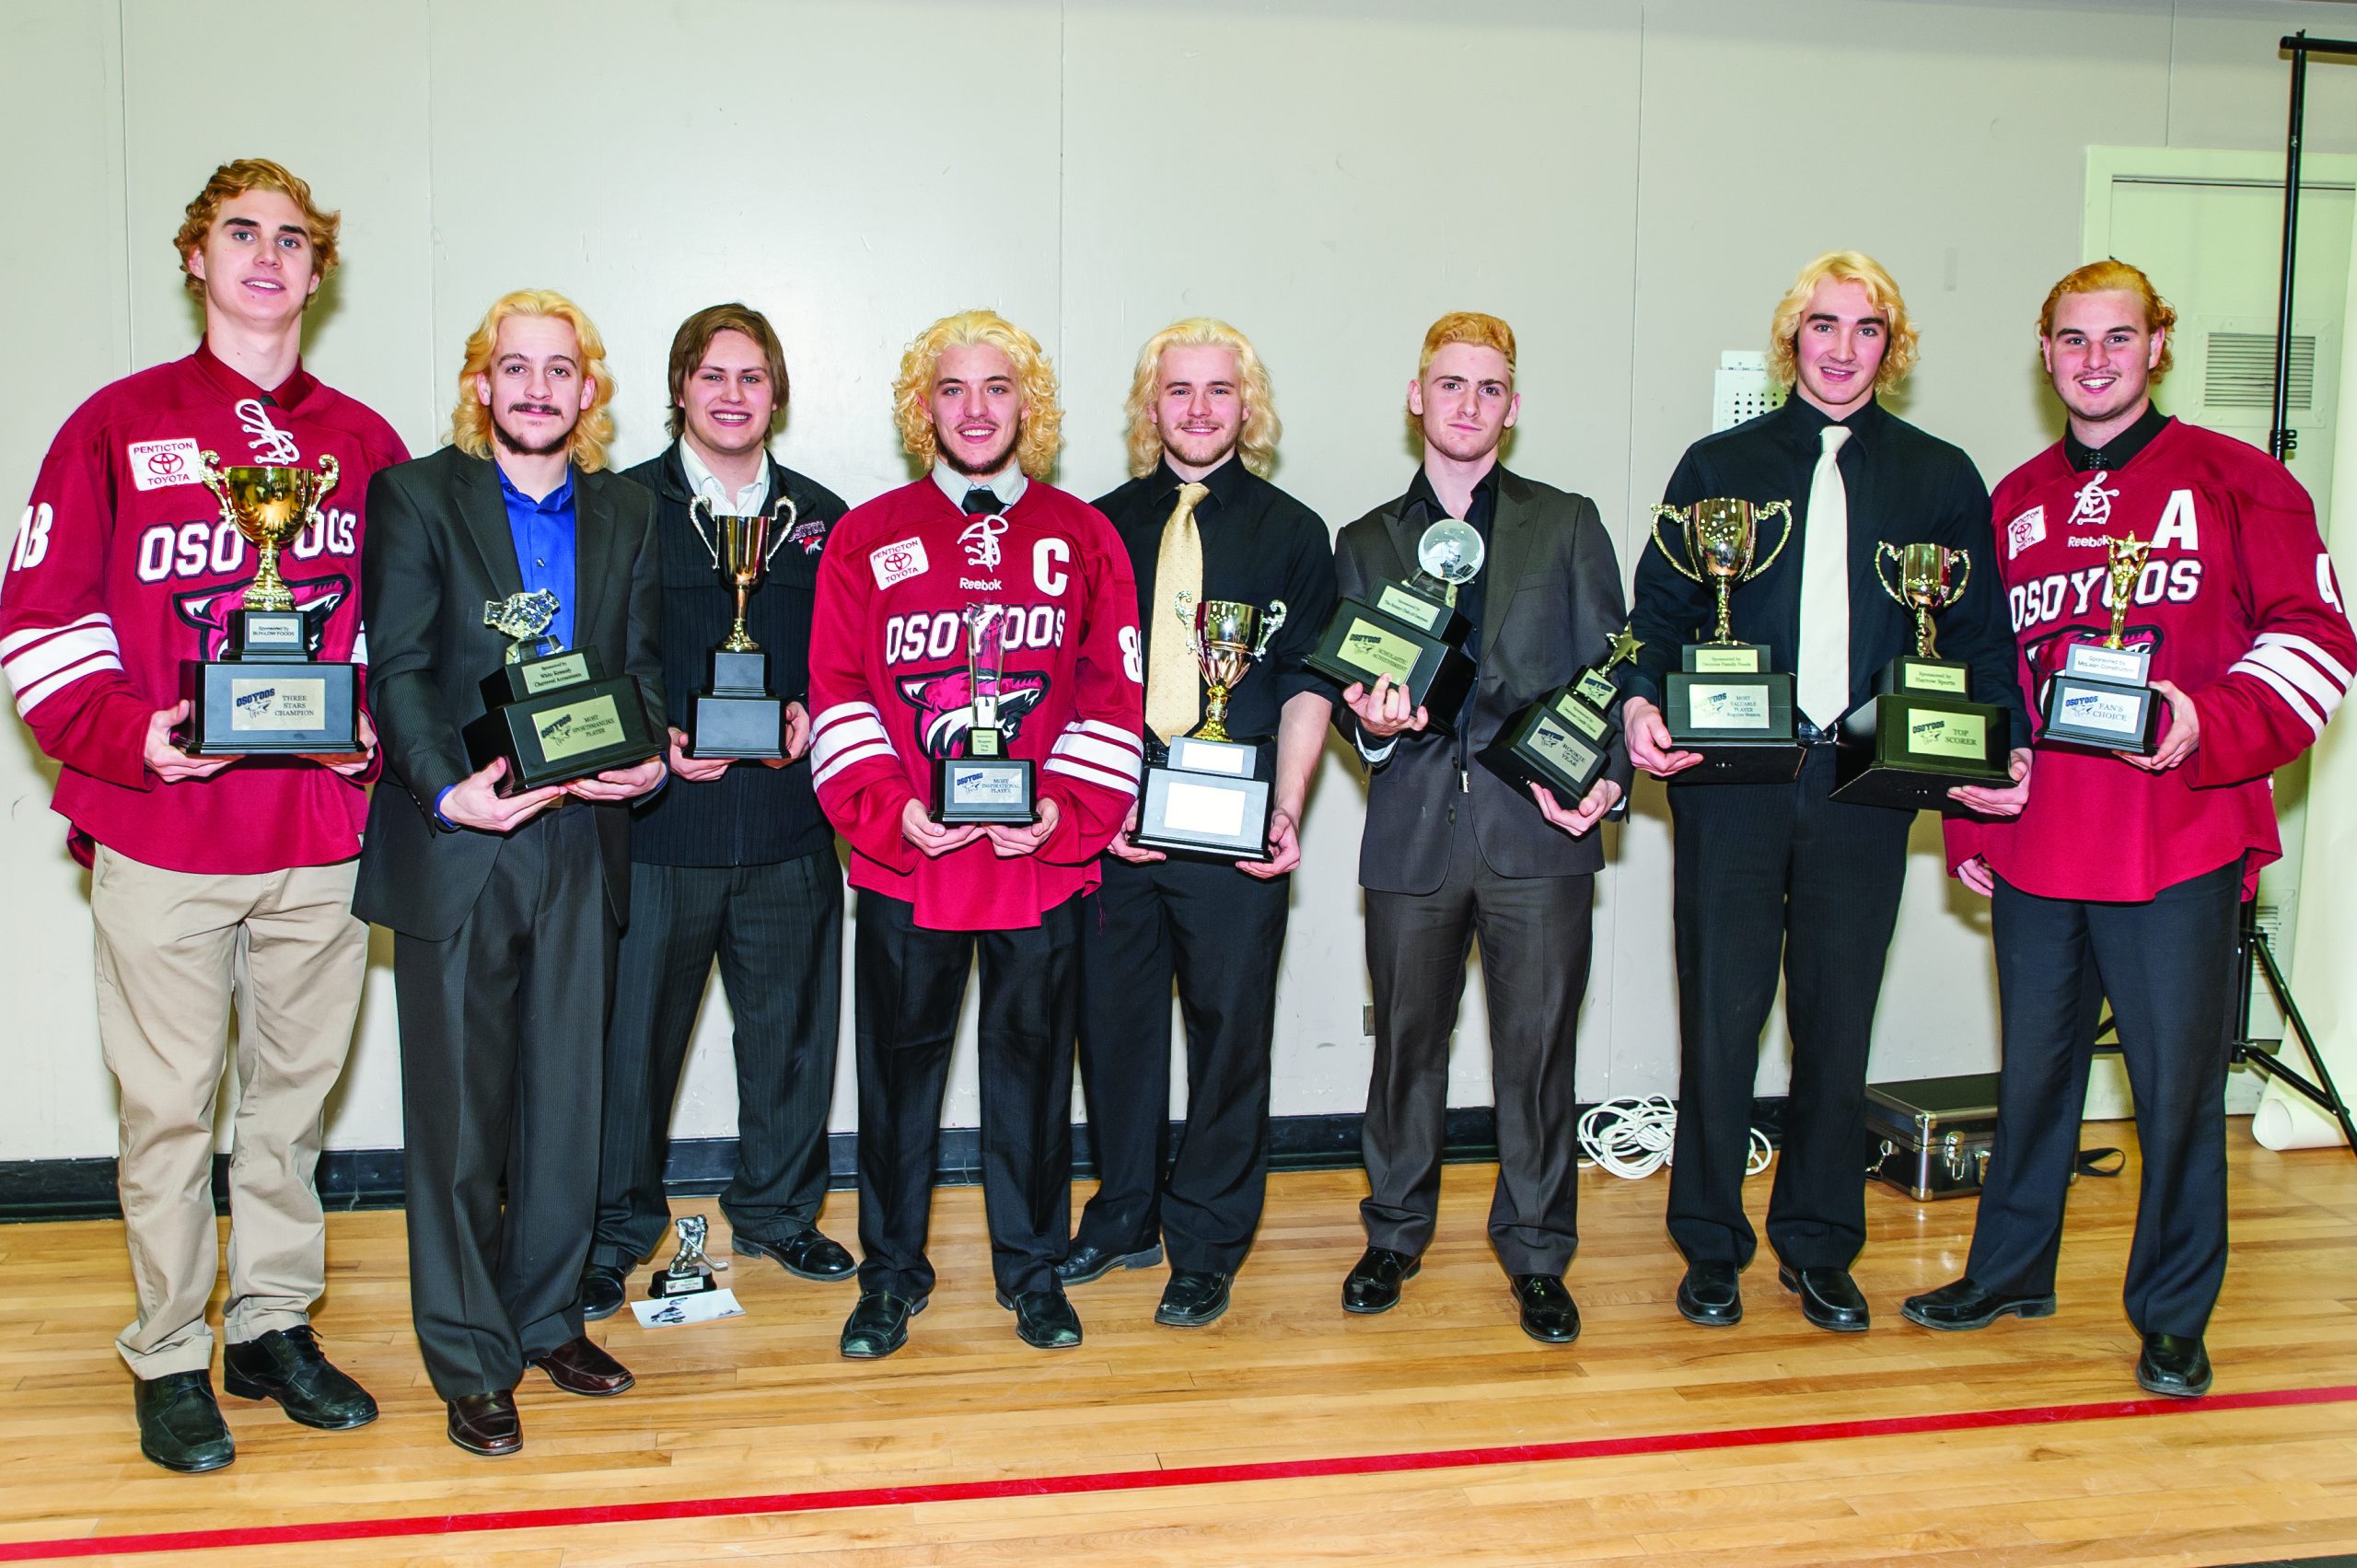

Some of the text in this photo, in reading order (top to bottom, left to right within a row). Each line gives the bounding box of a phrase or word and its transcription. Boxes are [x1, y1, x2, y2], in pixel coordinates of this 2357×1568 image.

[134, 442, 193, 455] PENTICTON
[147, 473, 191, 485] TOYOTA
[2151, 489, 2199, 551] A
[136, 507, 357, 584] OSOOOS
[2067, 535, 2109, 548] Reebok
[873, 540, 919, 562] PENTICTON
[1033, 538, 1070, 597] C
[885, 567, 919, 583] TOYOTA
[959, 577, 1003, 591] Reebok
[885, 602, 1066, 667] OSOYOOS
[236, 688, 275, 707] OSOYOOS
[2065, 695, 2098, 707] OSOYOOS
[2093, 711, 2127, 721] CHOICE
[1952, 728, 1969, 737] TOP
[1945, 737, 1977, 746] SCORER
